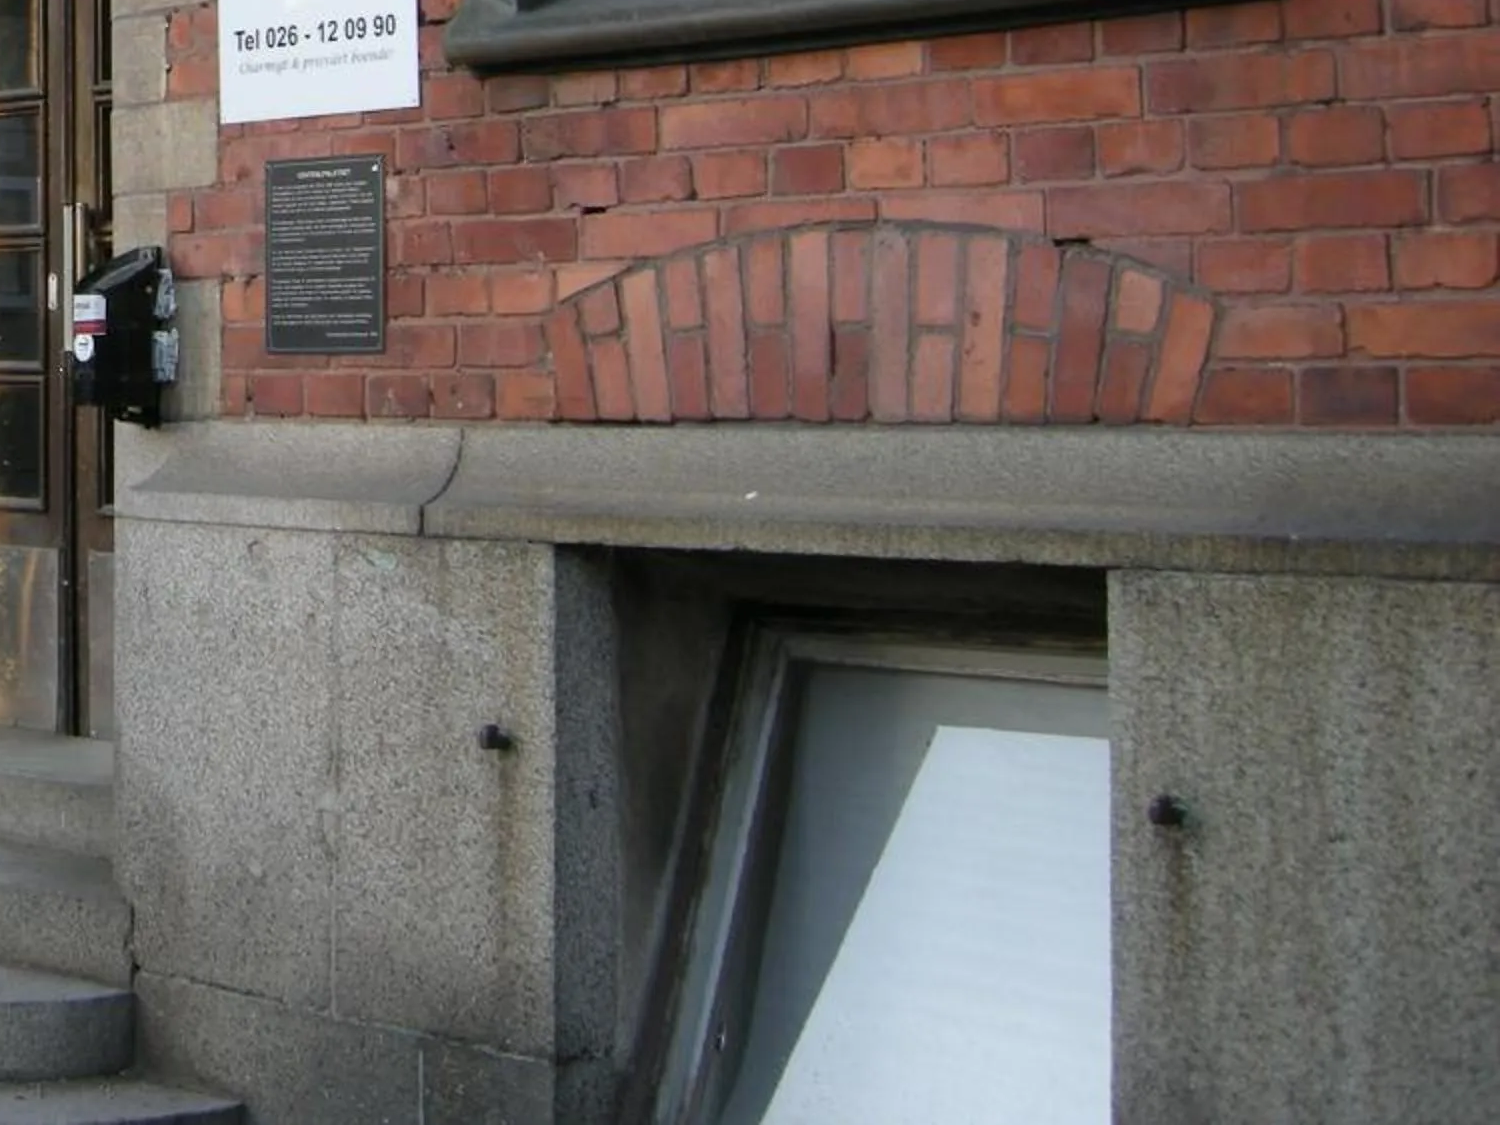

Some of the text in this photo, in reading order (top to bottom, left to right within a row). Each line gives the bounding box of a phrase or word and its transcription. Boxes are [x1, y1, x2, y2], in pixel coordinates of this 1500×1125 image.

[234, 30, 260, 52] Tel
[265, 25, 298, 48] 026
[317, 20, 338, 43] 12
[344, 17, 367, 40] 09
[373, 13, 396, 38] 90
